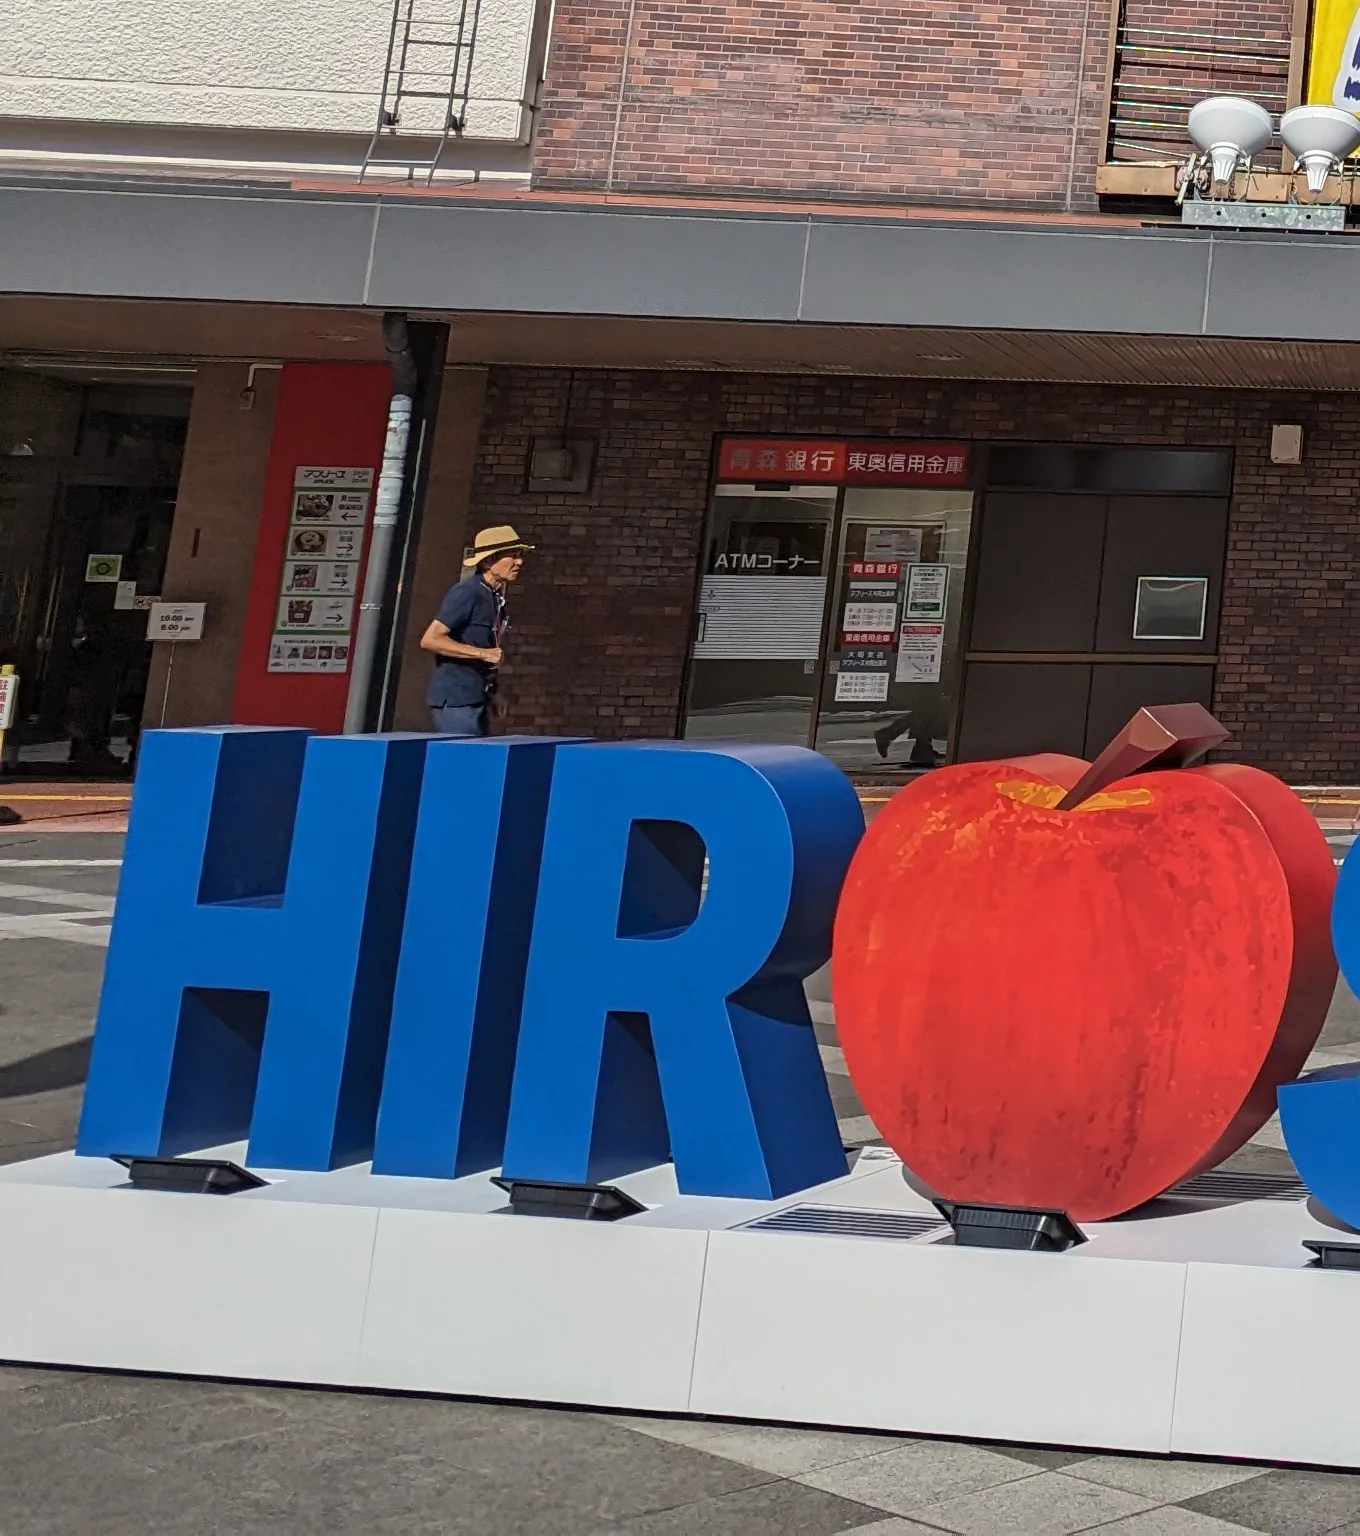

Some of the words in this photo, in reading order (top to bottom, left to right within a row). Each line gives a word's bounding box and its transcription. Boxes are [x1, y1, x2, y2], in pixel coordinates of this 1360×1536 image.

[729, 449, 835, 472] 青森銀行
[847, 451, 965, 474] 東奥信用金庫
[714, 553, 821, 569] ATMコーナー
